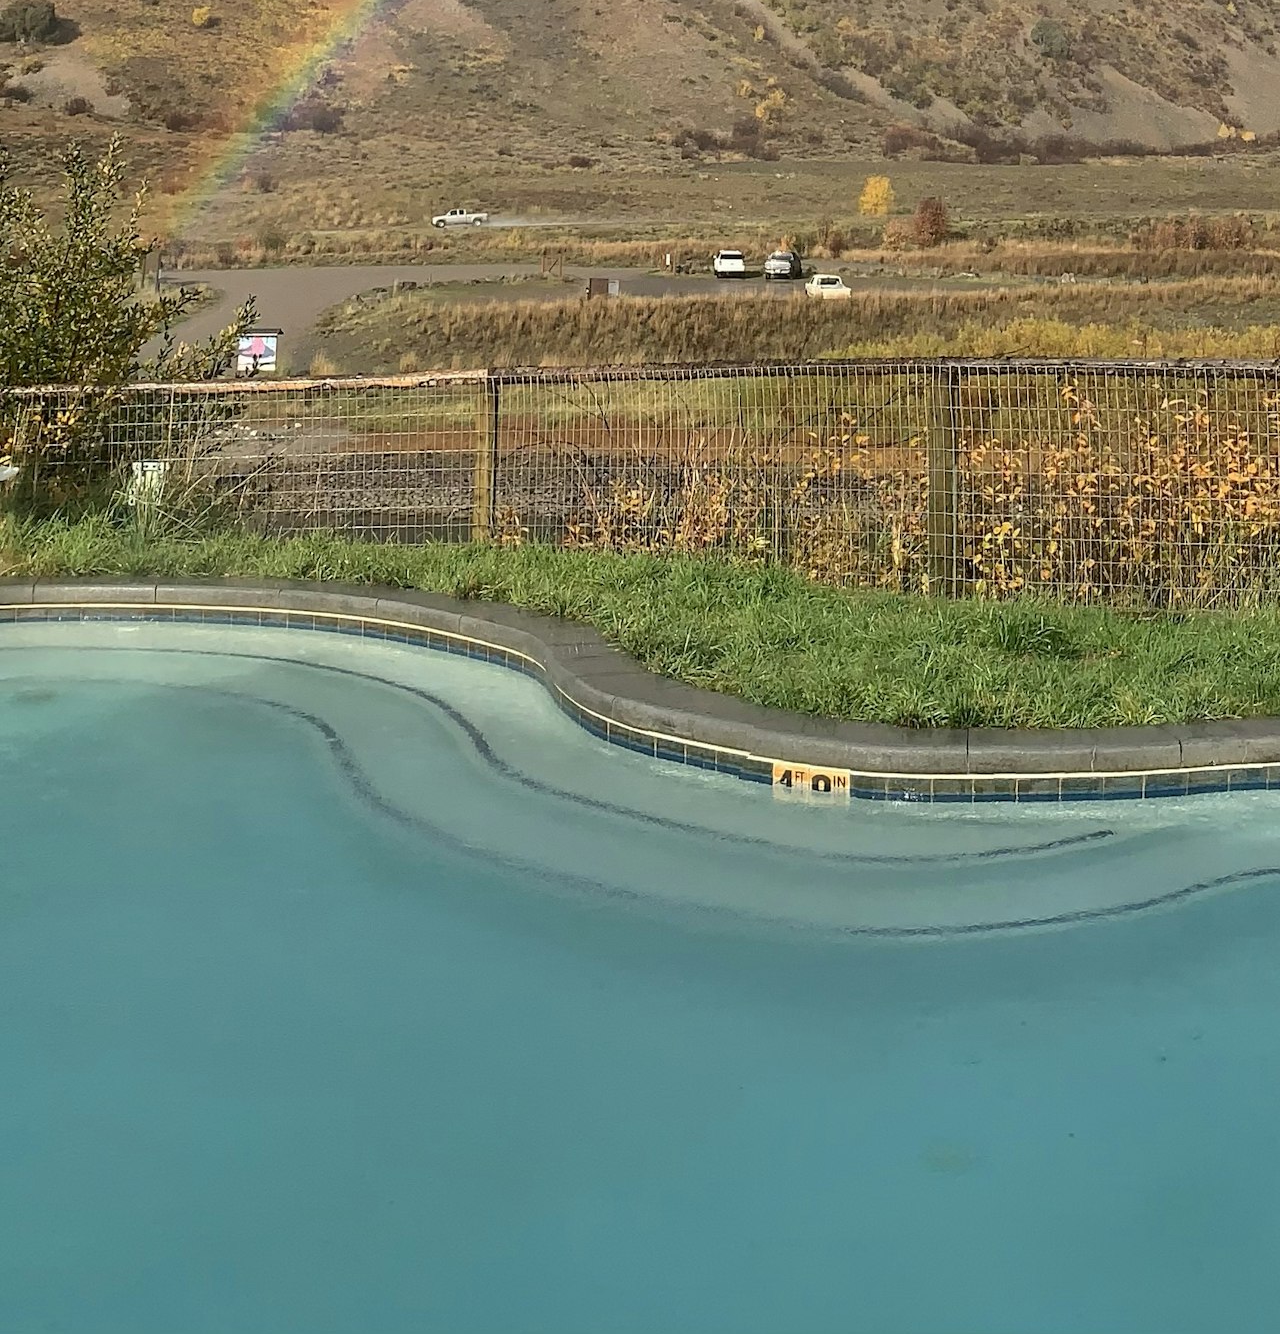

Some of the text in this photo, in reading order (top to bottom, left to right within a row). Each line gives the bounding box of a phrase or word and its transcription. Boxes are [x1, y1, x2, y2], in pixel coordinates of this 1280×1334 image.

[780, 770, 846, 792] 4 FT 0 IN
